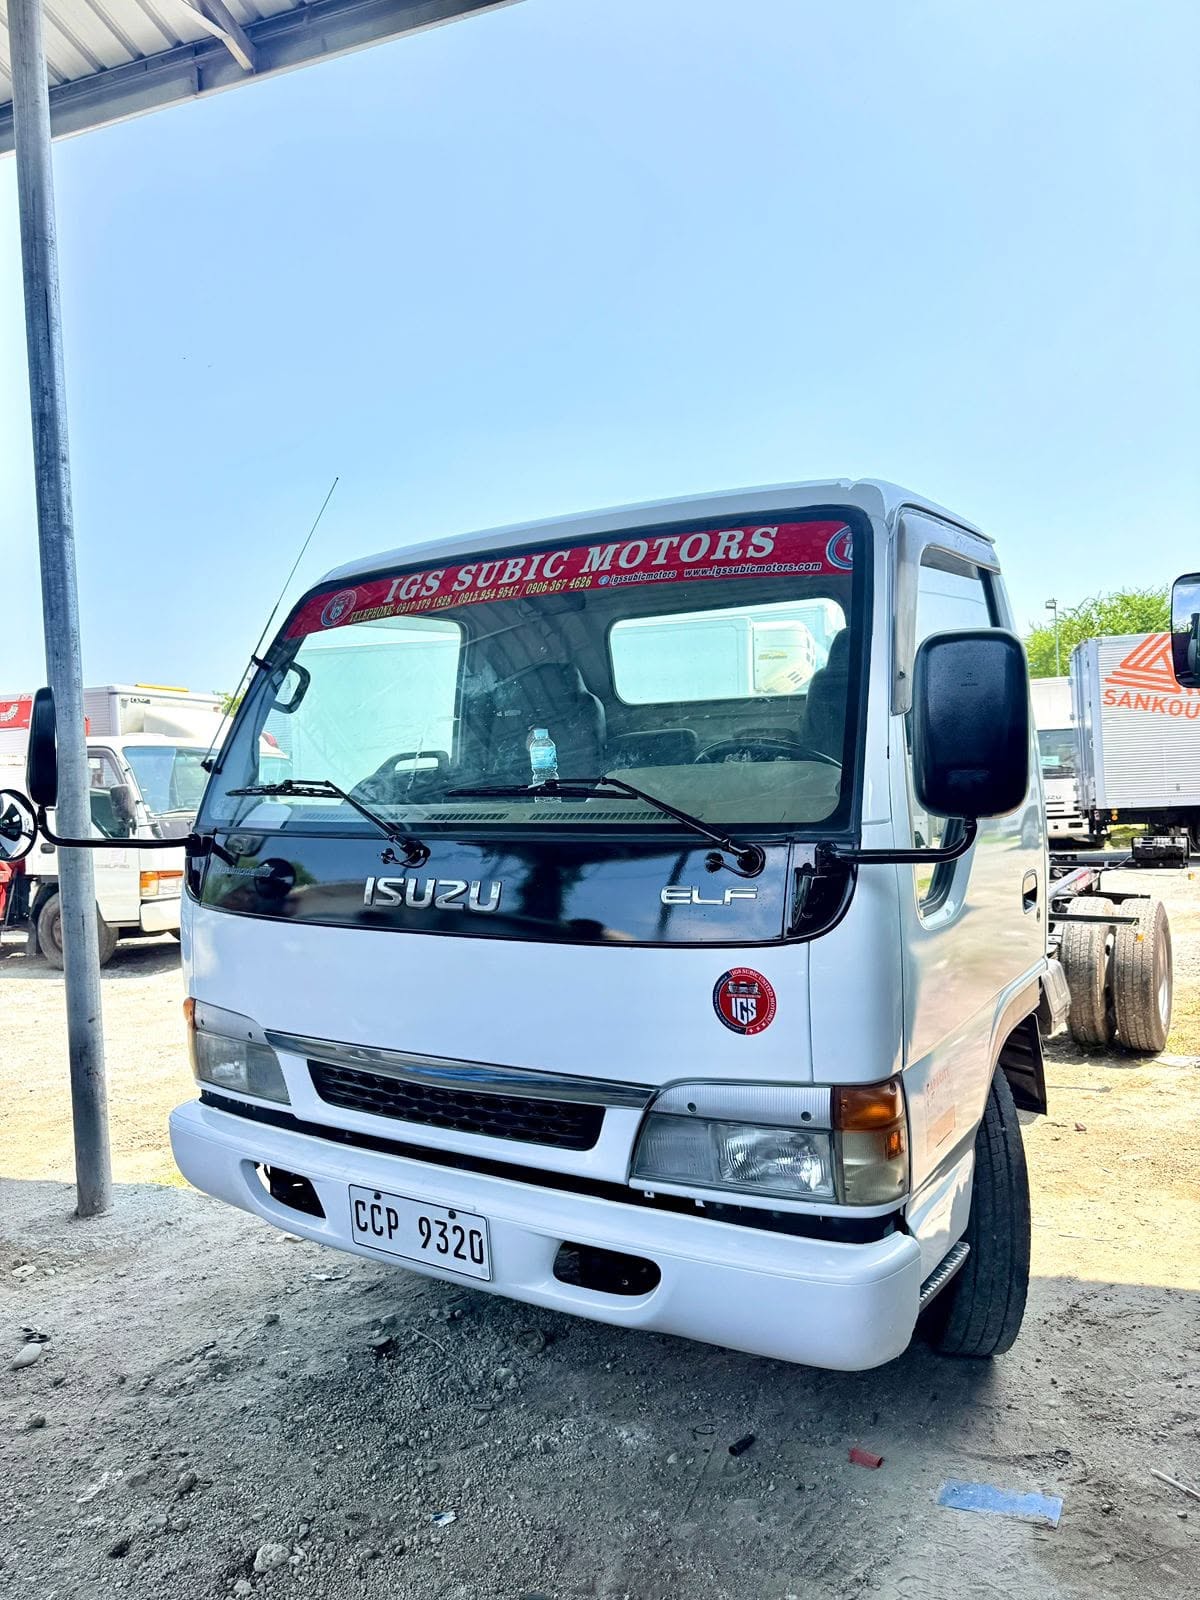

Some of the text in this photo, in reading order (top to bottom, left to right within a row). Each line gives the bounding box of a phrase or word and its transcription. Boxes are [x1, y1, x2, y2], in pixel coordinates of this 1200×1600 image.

[383, 526, 778, 603] IGS SUBIC MOTORS
[610, 562, 822, 585] igssubicmotors www.igssubicmotors.com
[1103, 688, 1200, 719] SANKOU
[363, 876, 502, 913] ISUZU
[660, 885, 758, 906] ELF
[732, 997, 757, 1025] IGS
[354, 1199, 484, 1264] CCP 9320
